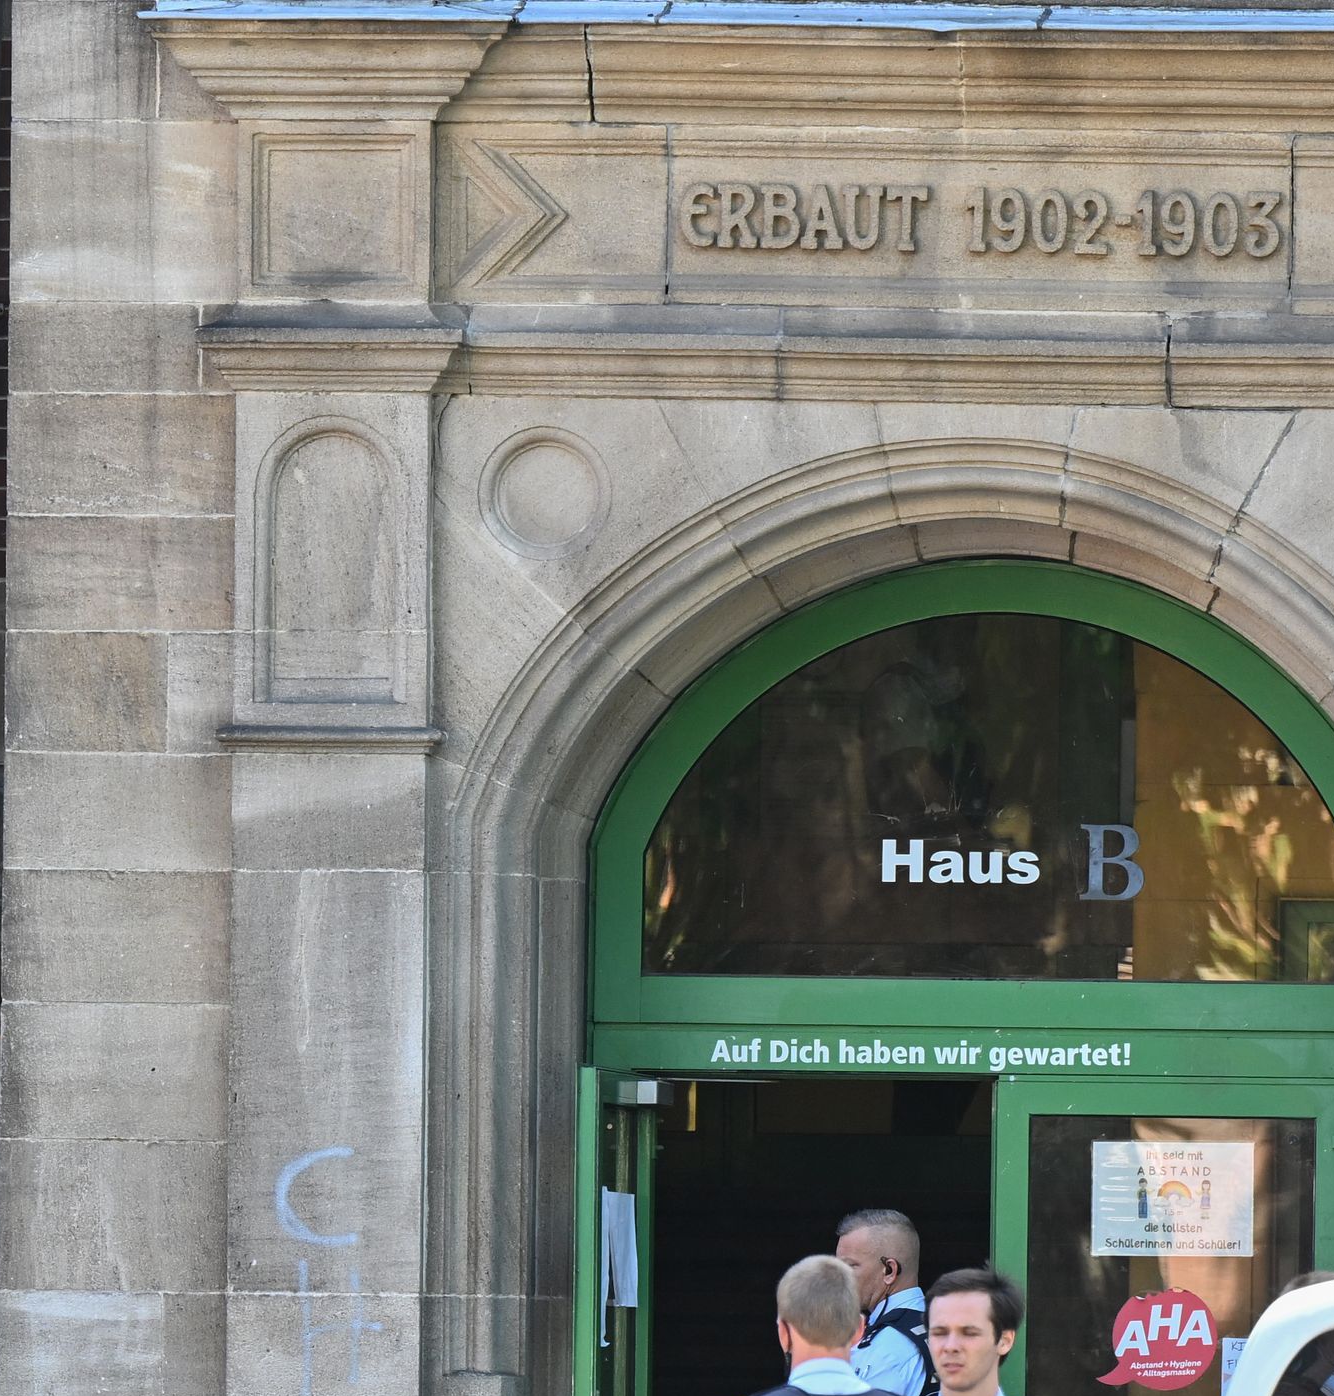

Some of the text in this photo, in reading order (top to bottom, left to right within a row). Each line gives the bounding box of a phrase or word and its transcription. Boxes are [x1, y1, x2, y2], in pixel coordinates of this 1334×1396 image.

[679, 182, 1284, 259] ERBAUT 1902-1903
[881, 823, 1146, 902] Haus B
[711, 1038, 1133, 1071] Auf Dich haben wir gewartet!
[1163, 1151, 1184, 1161] seid
[1187, 1151, 1204, 1161] mit
[1137, 1166, 1212, 1177] ABSTAND
[1144, 1222, 1203, 1233] die tollsten
[1105, 1238, 1242, 1250] Schülerinnen und Schüler!
[1114, 1303, 1213, 1357] AHA
[1130, 1360, 1163, 1370] Abstand
[1169, 1359, 1202, 1370] Hygiene
[1142, 1368, 1196, 1379] Alltagsmaske
